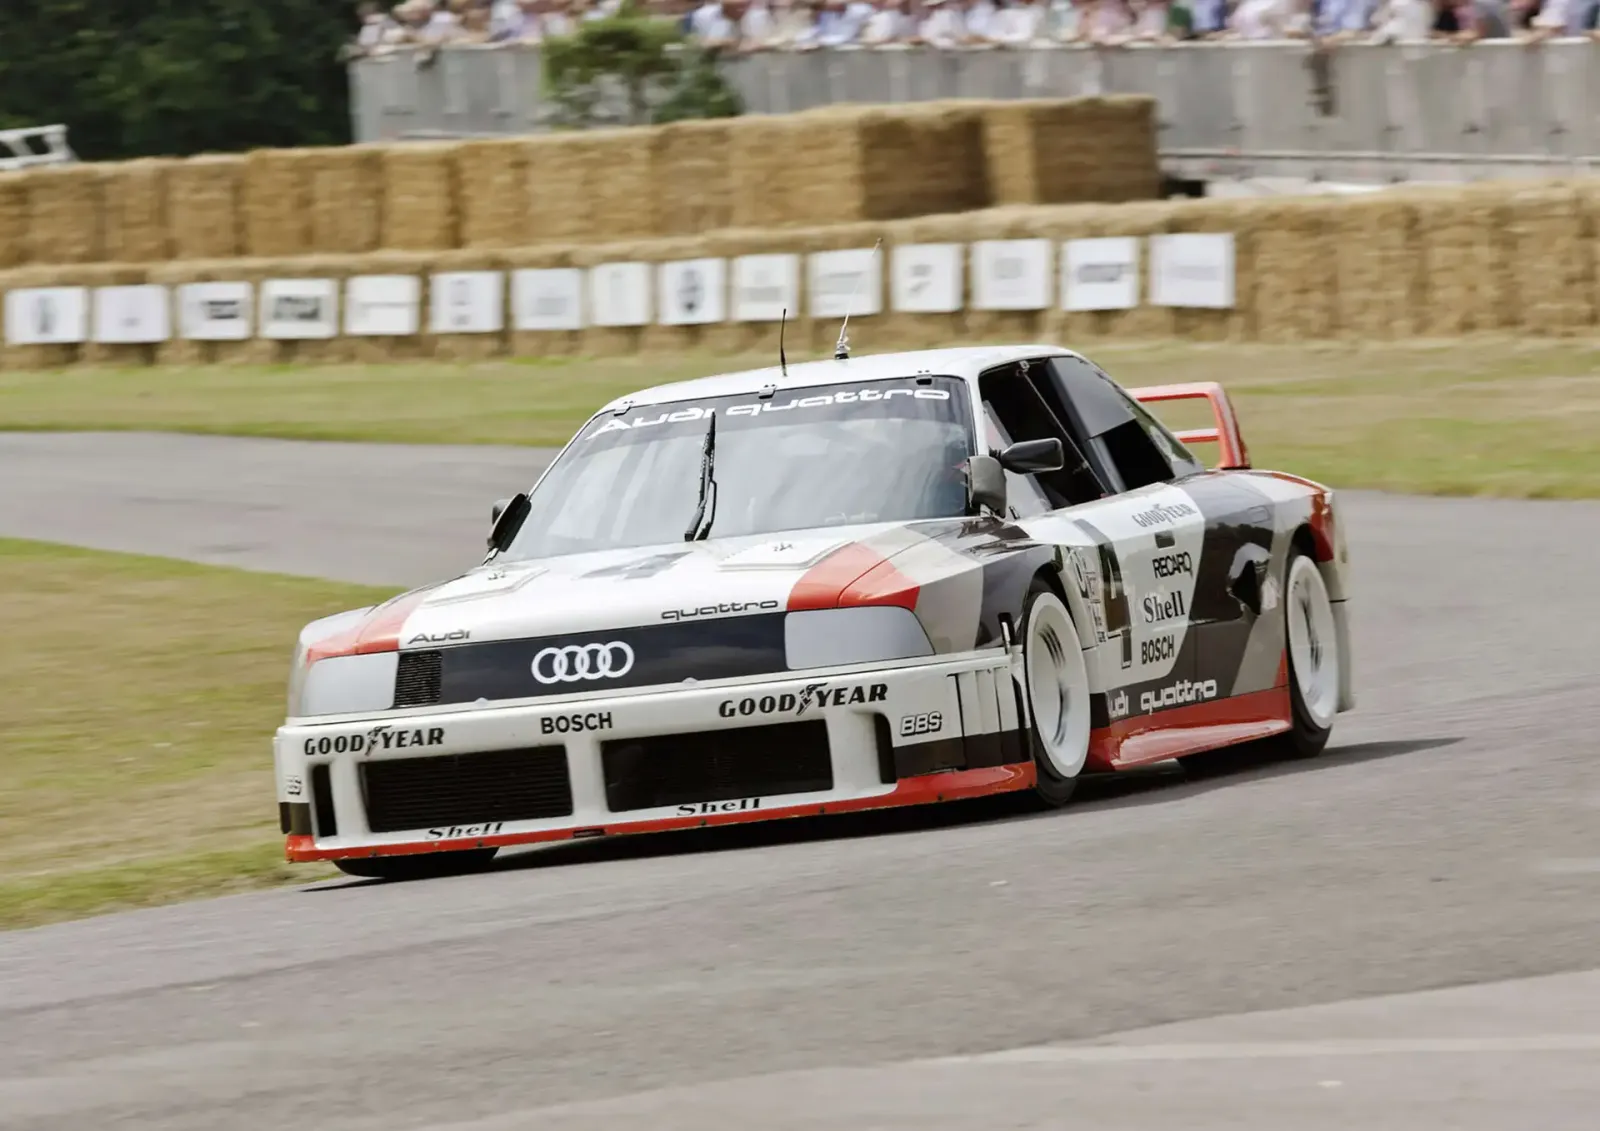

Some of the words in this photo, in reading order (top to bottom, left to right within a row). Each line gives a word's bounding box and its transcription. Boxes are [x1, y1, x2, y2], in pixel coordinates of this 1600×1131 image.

[584, 407, 716, 441] Audi
[725, 388, 950, 417] quattro
[1132, 503, 1197, 528] GOODYEAR
[1152, 552, 1193, 579] RECARO
[660, 599, 779, 621] quattro
[1143, 590, 1186, 623] Shell
[408, 629, 471, 645] Audi
[1141, 635, 1175, 665] BOSCH
[719, 682, 889, 718] GOODYEAR
[1107, 690, 1129, 716] udi
[1140, 679, 1218, 716] quattro
[541, 711, 614, 735] BOSCH
[900, 710, 943, 736] BBS
[304, 726, 446, 756] GOODYEAR
[676, 797, 761, 817] Shell
[425, 821, 504, 841] Shell
